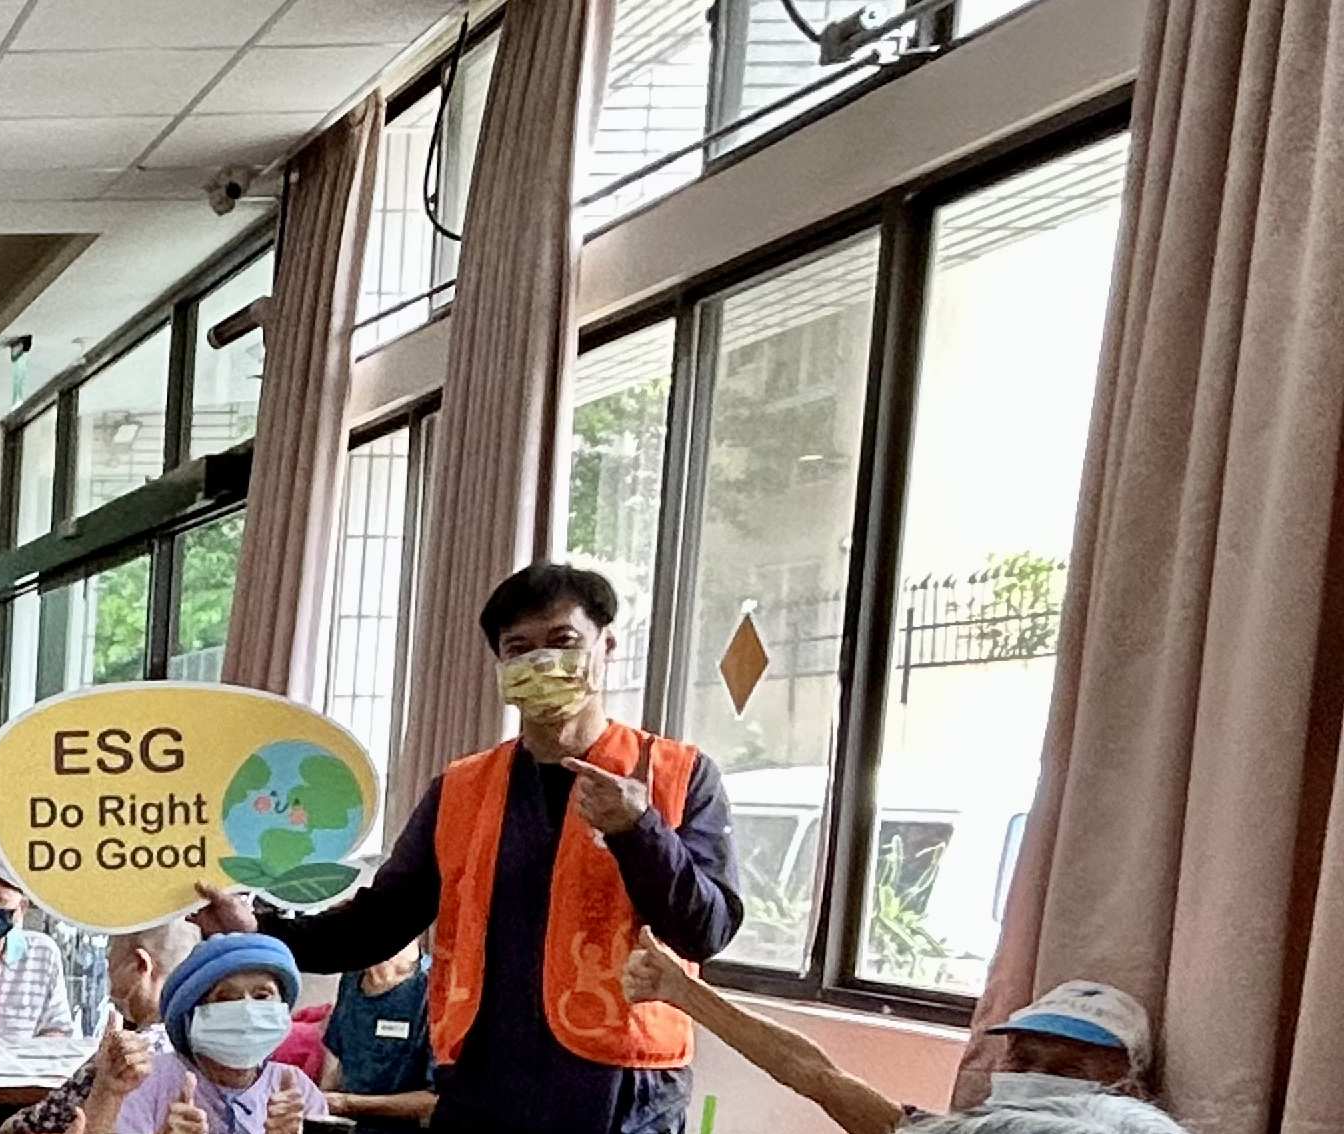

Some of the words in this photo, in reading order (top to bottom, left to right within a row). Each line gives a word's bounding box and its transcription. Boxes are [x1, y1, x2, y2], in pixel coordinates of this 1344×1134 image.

[53, 728, 185, 775] ESG
[29, 797, 84, 829] Do
[99, 792, 209, 833] Right
[28, 841, 82, 873] Do
[97, 836, 207, 871] Good
